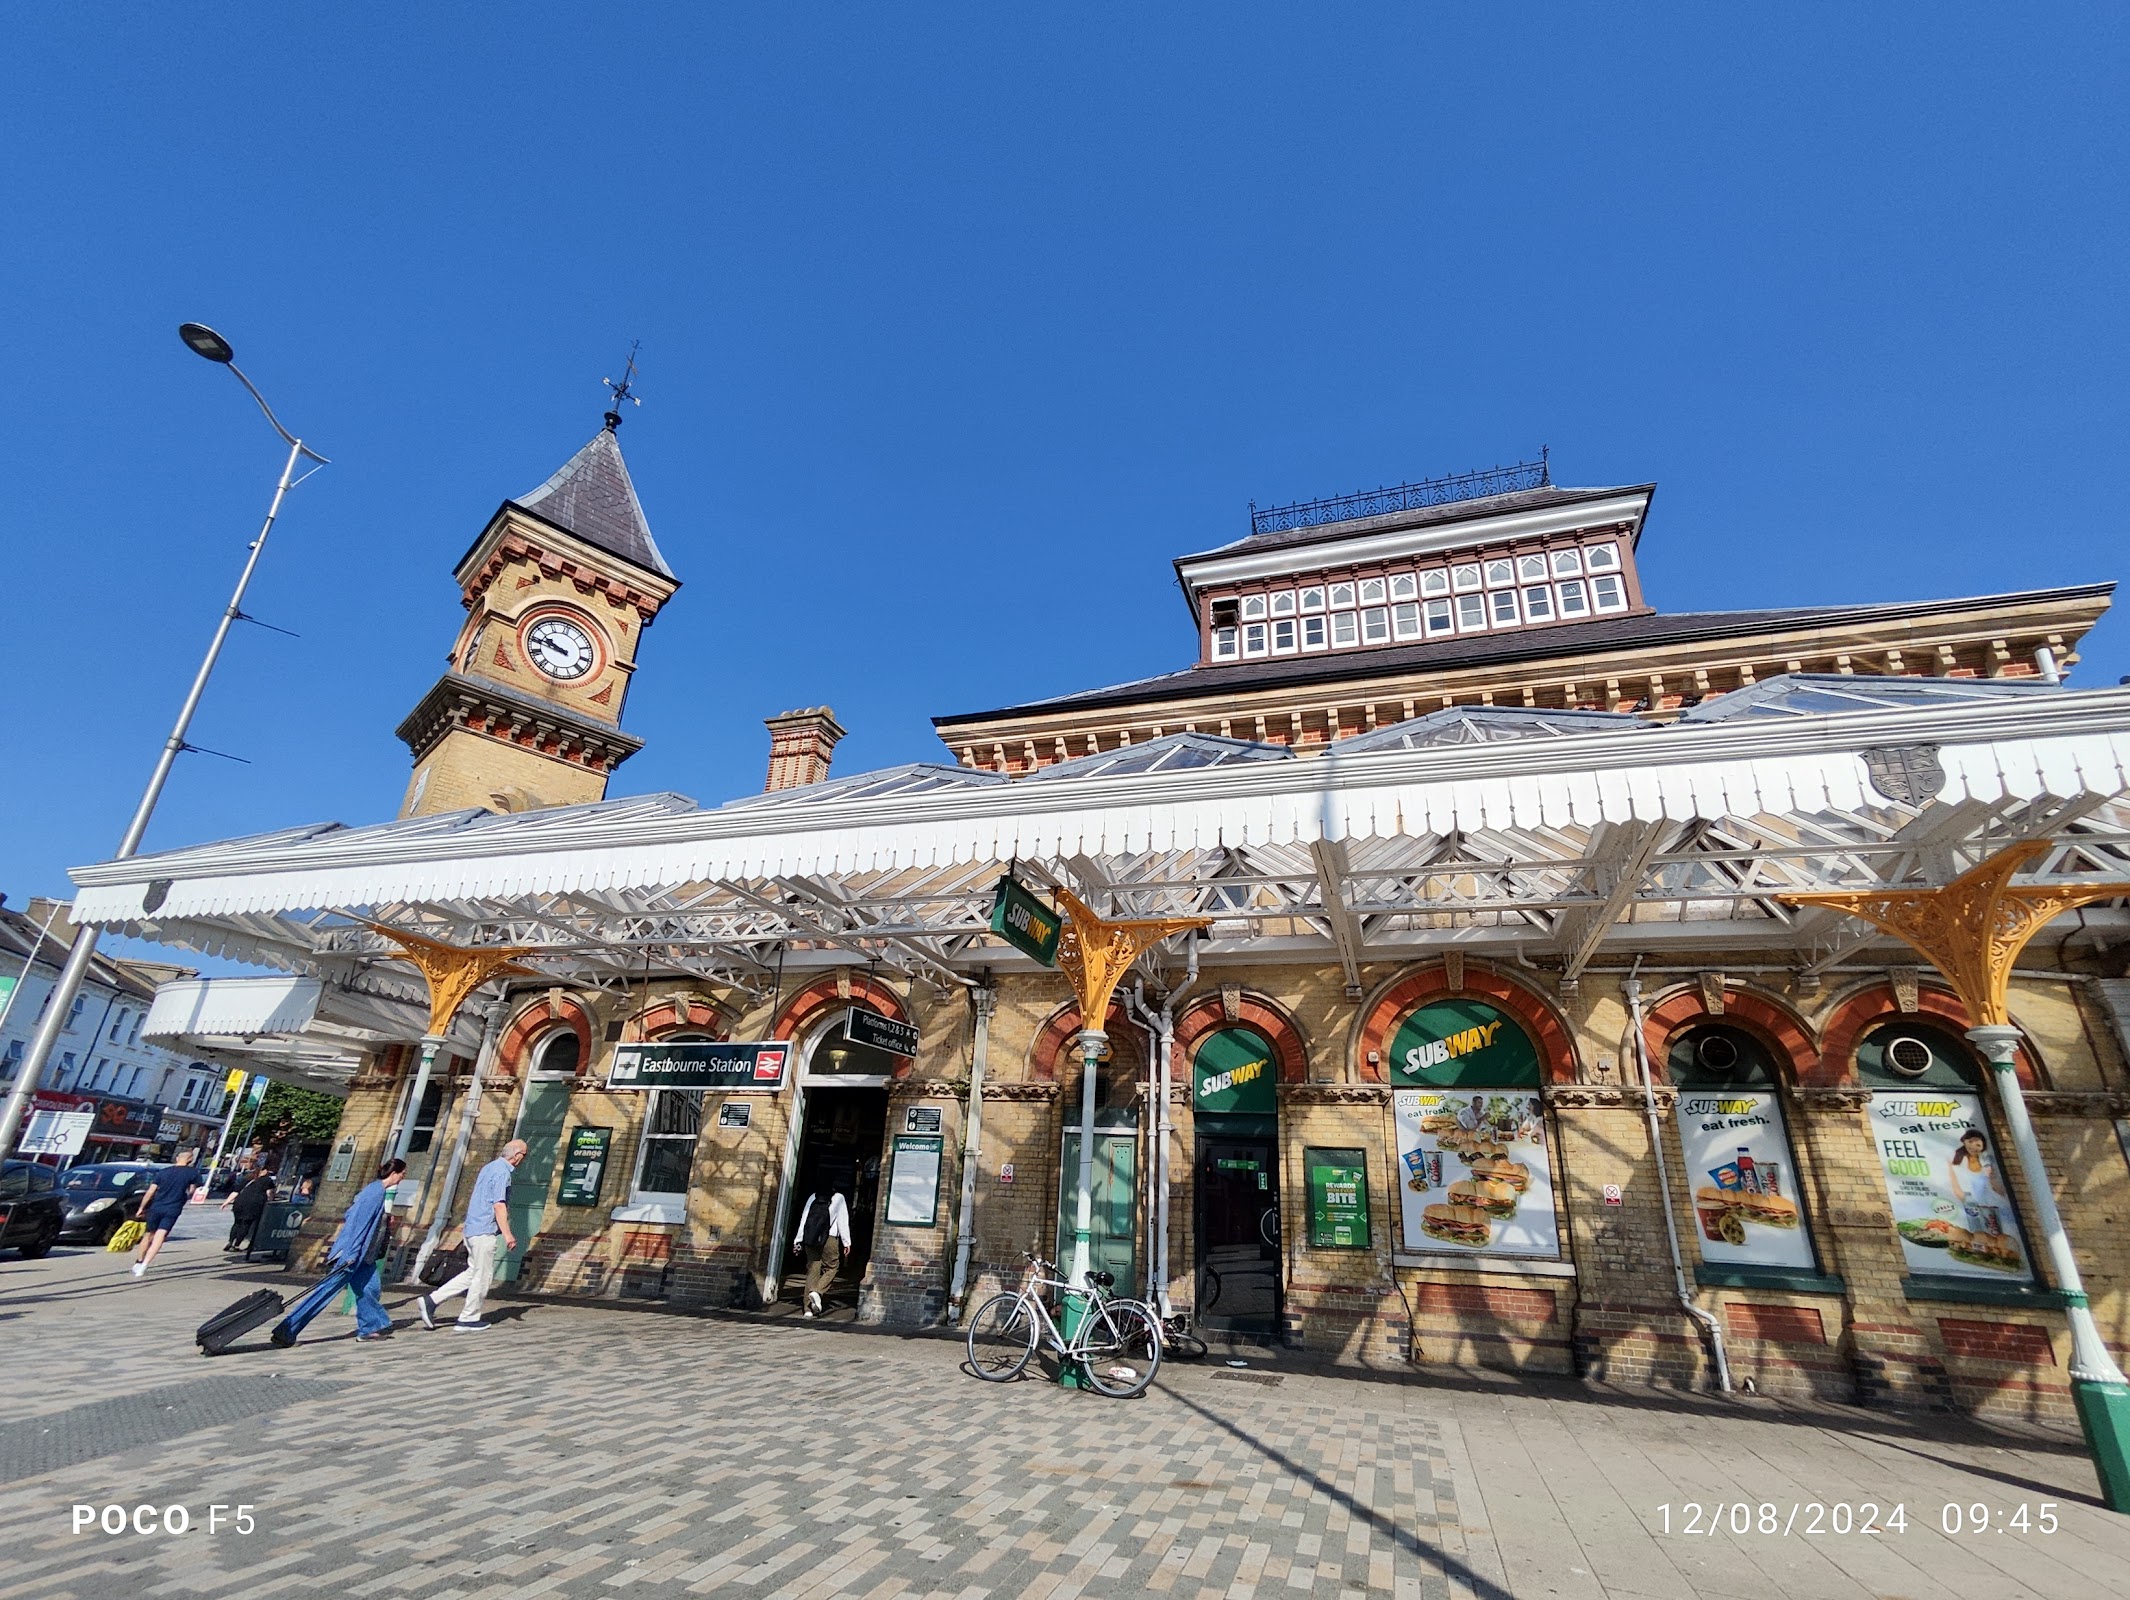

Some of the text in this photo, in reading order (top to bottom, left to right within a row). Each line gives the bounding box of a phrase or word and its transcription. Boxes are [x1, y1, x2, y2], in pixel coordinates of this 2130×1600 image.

[1007, 902, 1051, 944] SUBWAY
[862, 1014, 888, 1031] Platforms
[872, 1033, 902, 1050] Ticket office
[1402, 1020, 1502, 1075] SUBWAY
[641, 1056, 752, 1073] Eastbourne Station
[1200, 1058, 1268, 1097] SUBWAY
[1398, 1094, 1447, 1107] SUBWAY
[1684, 1098, 1758, 1116] SUBWAY
[1879, 1099, 1962, 1118] SUBWAY
[1407, 1110, 1423, 1119] eat
[1701, 1121, 1725, 1131] eat
[1899, 1123, 1925, 1134] eat
[577, 1137, 601, 1146] green
[898, 1142, 930, 1151] Welcome
[1882, 1140, 1926, 1158] FEEL
[573, 1149, 602, 1159] orange
[1887, 1159, 1930, 1176] GOOD
[1743, 1169, 1757, 1194] Oasis
[1326, 1192, 1357, 1204] BITE
